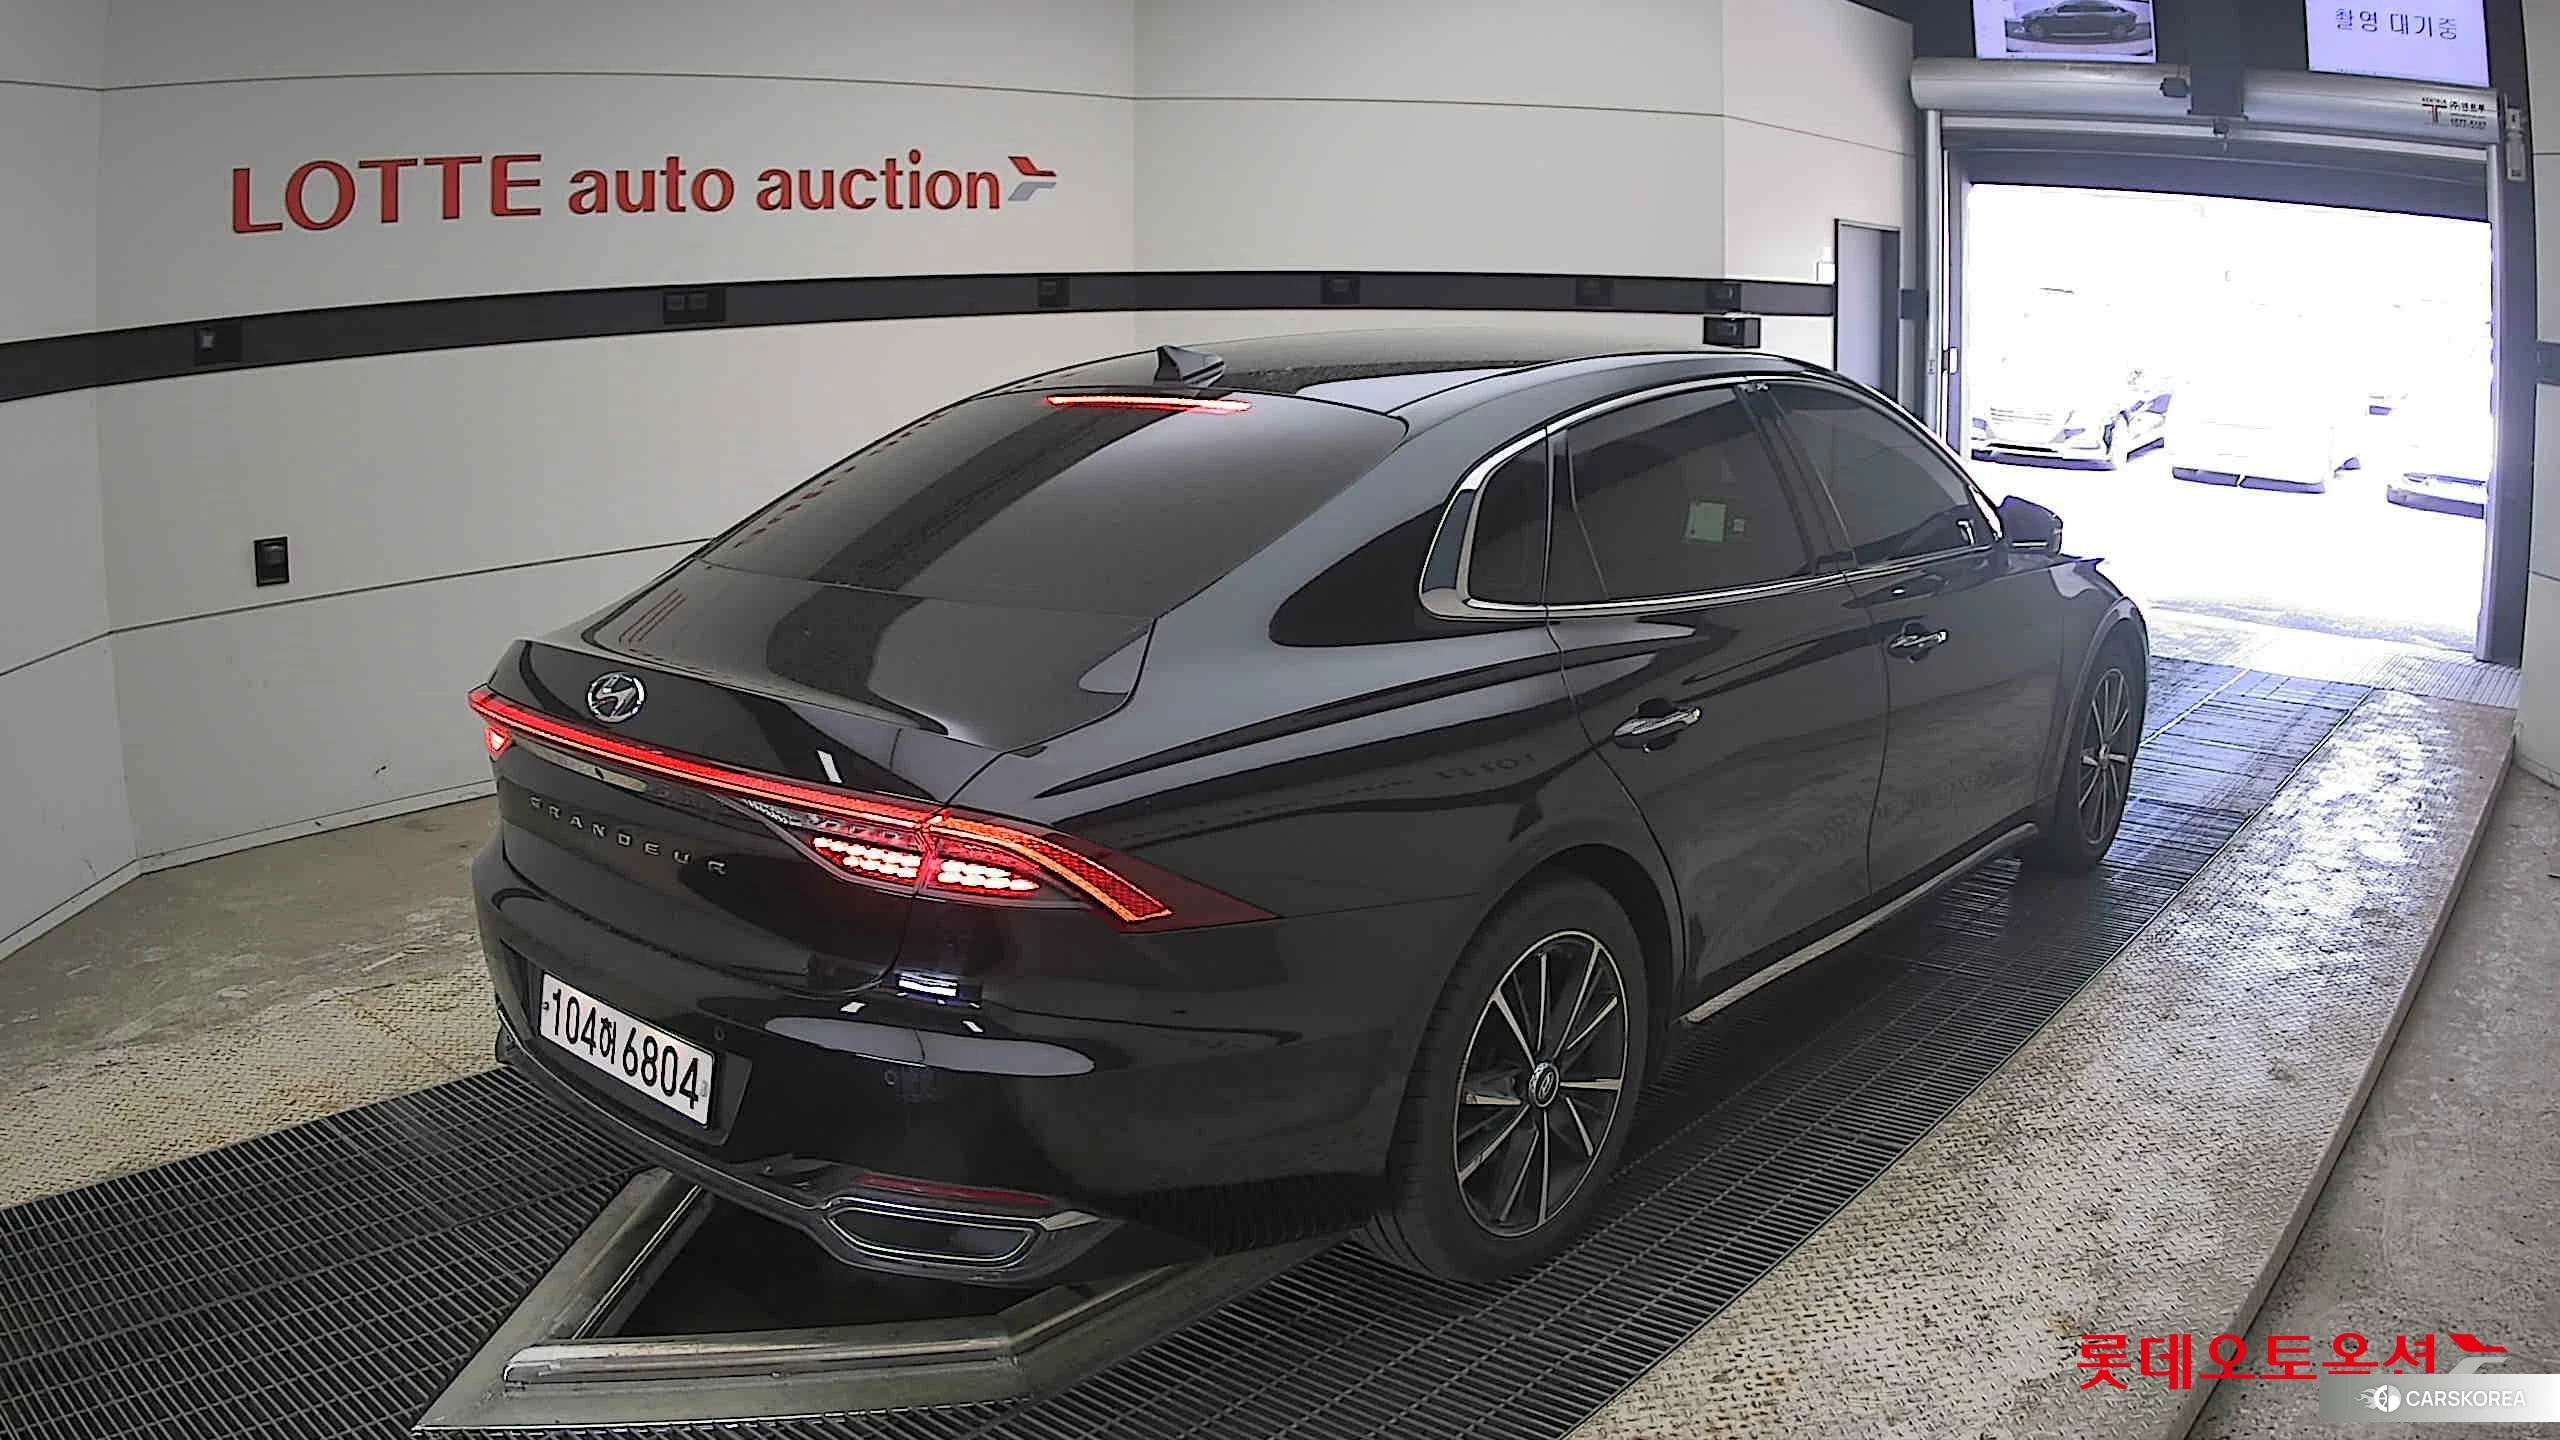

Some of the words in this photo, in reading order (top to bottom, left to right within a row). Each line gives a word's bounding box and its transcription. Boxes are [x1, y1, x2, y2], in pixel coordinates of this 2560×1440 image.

[2390, 13, 2457, 40] 대기중
[232, 154, 542, 233] LOTTE
[568, 156, 736, 214] auto
[756, 149, 1002, 211] auction
[529, 796, 726, 875] GRANDEUR
[622, 1026, 700, 1110] 6804
